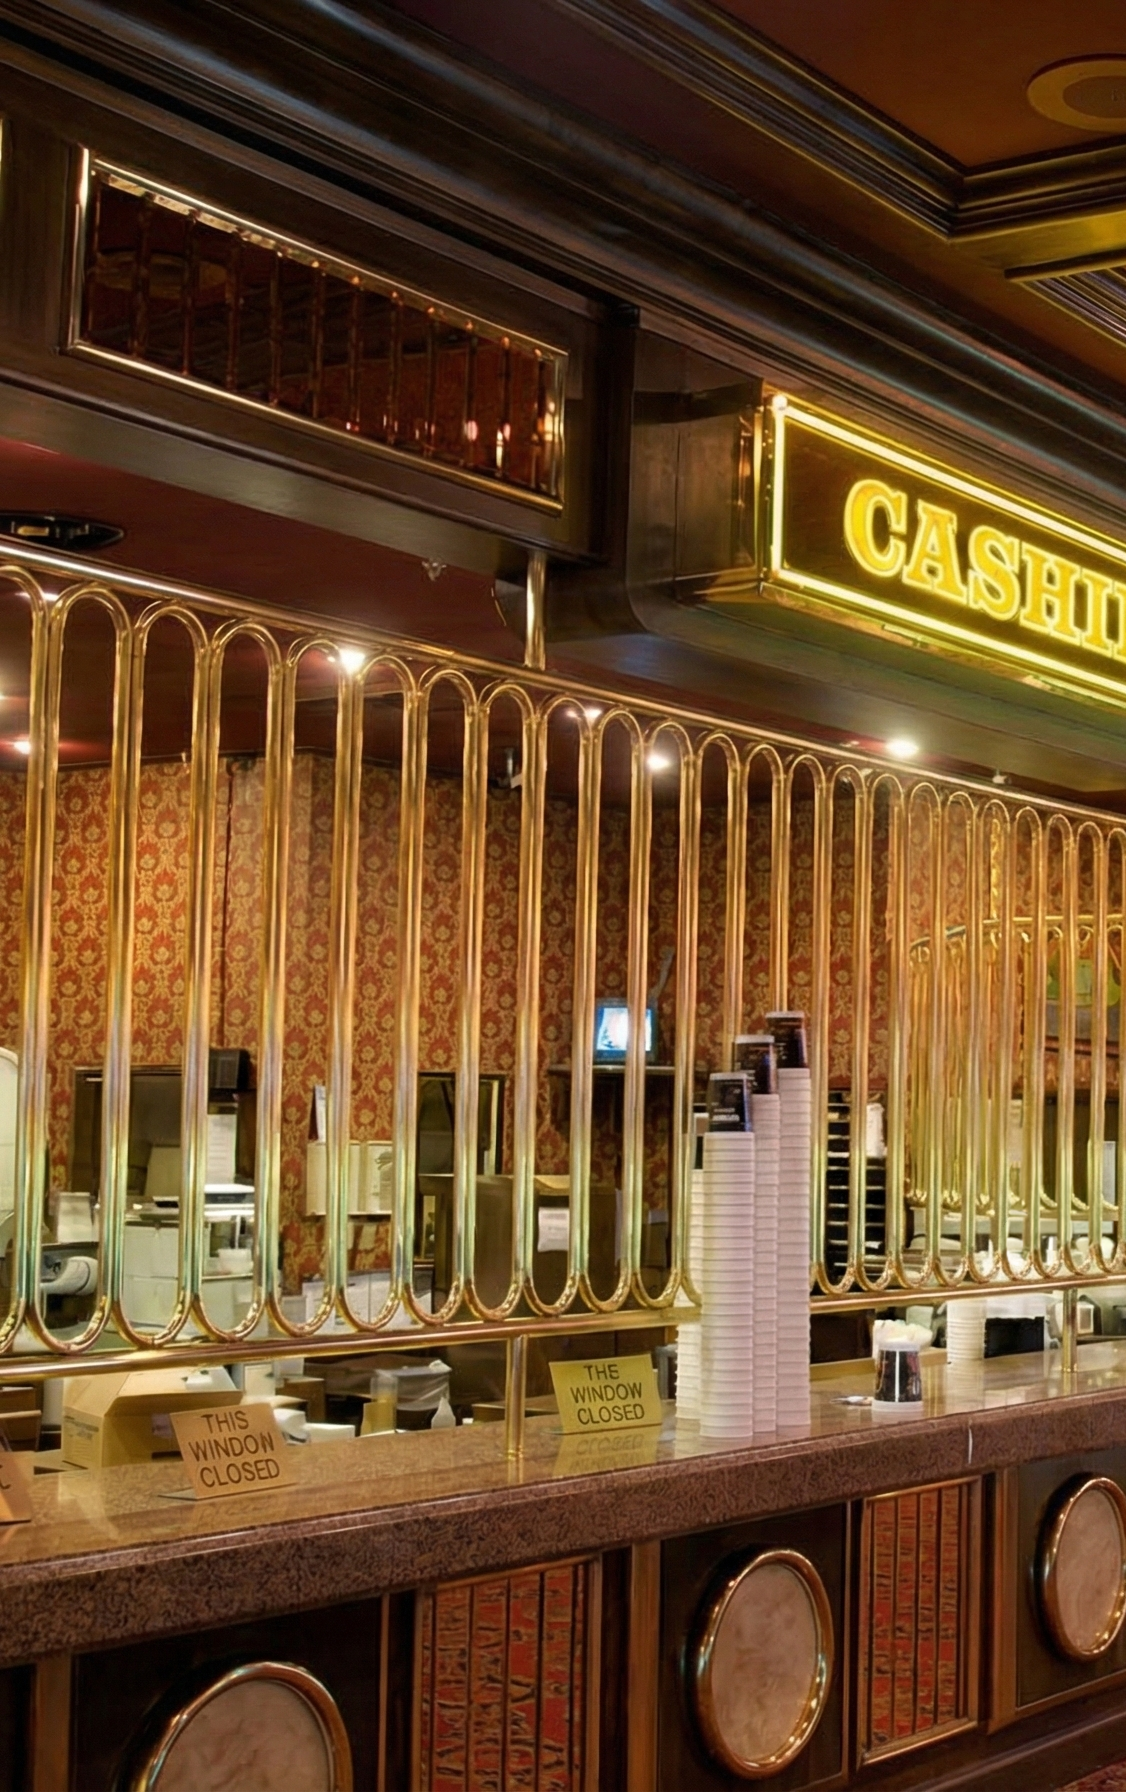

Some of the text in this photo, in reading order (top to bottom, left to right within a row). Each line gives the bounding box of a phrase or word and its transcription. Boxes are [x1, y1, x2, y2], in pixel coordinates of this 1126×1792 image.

[570, 1382, 642, 1404] WINDOW
[201, 1410, 249, 1434] THIS
[577, 1403, 645, 1425] CLOSED
[200, 1458, 280, 1488] CLOSED
